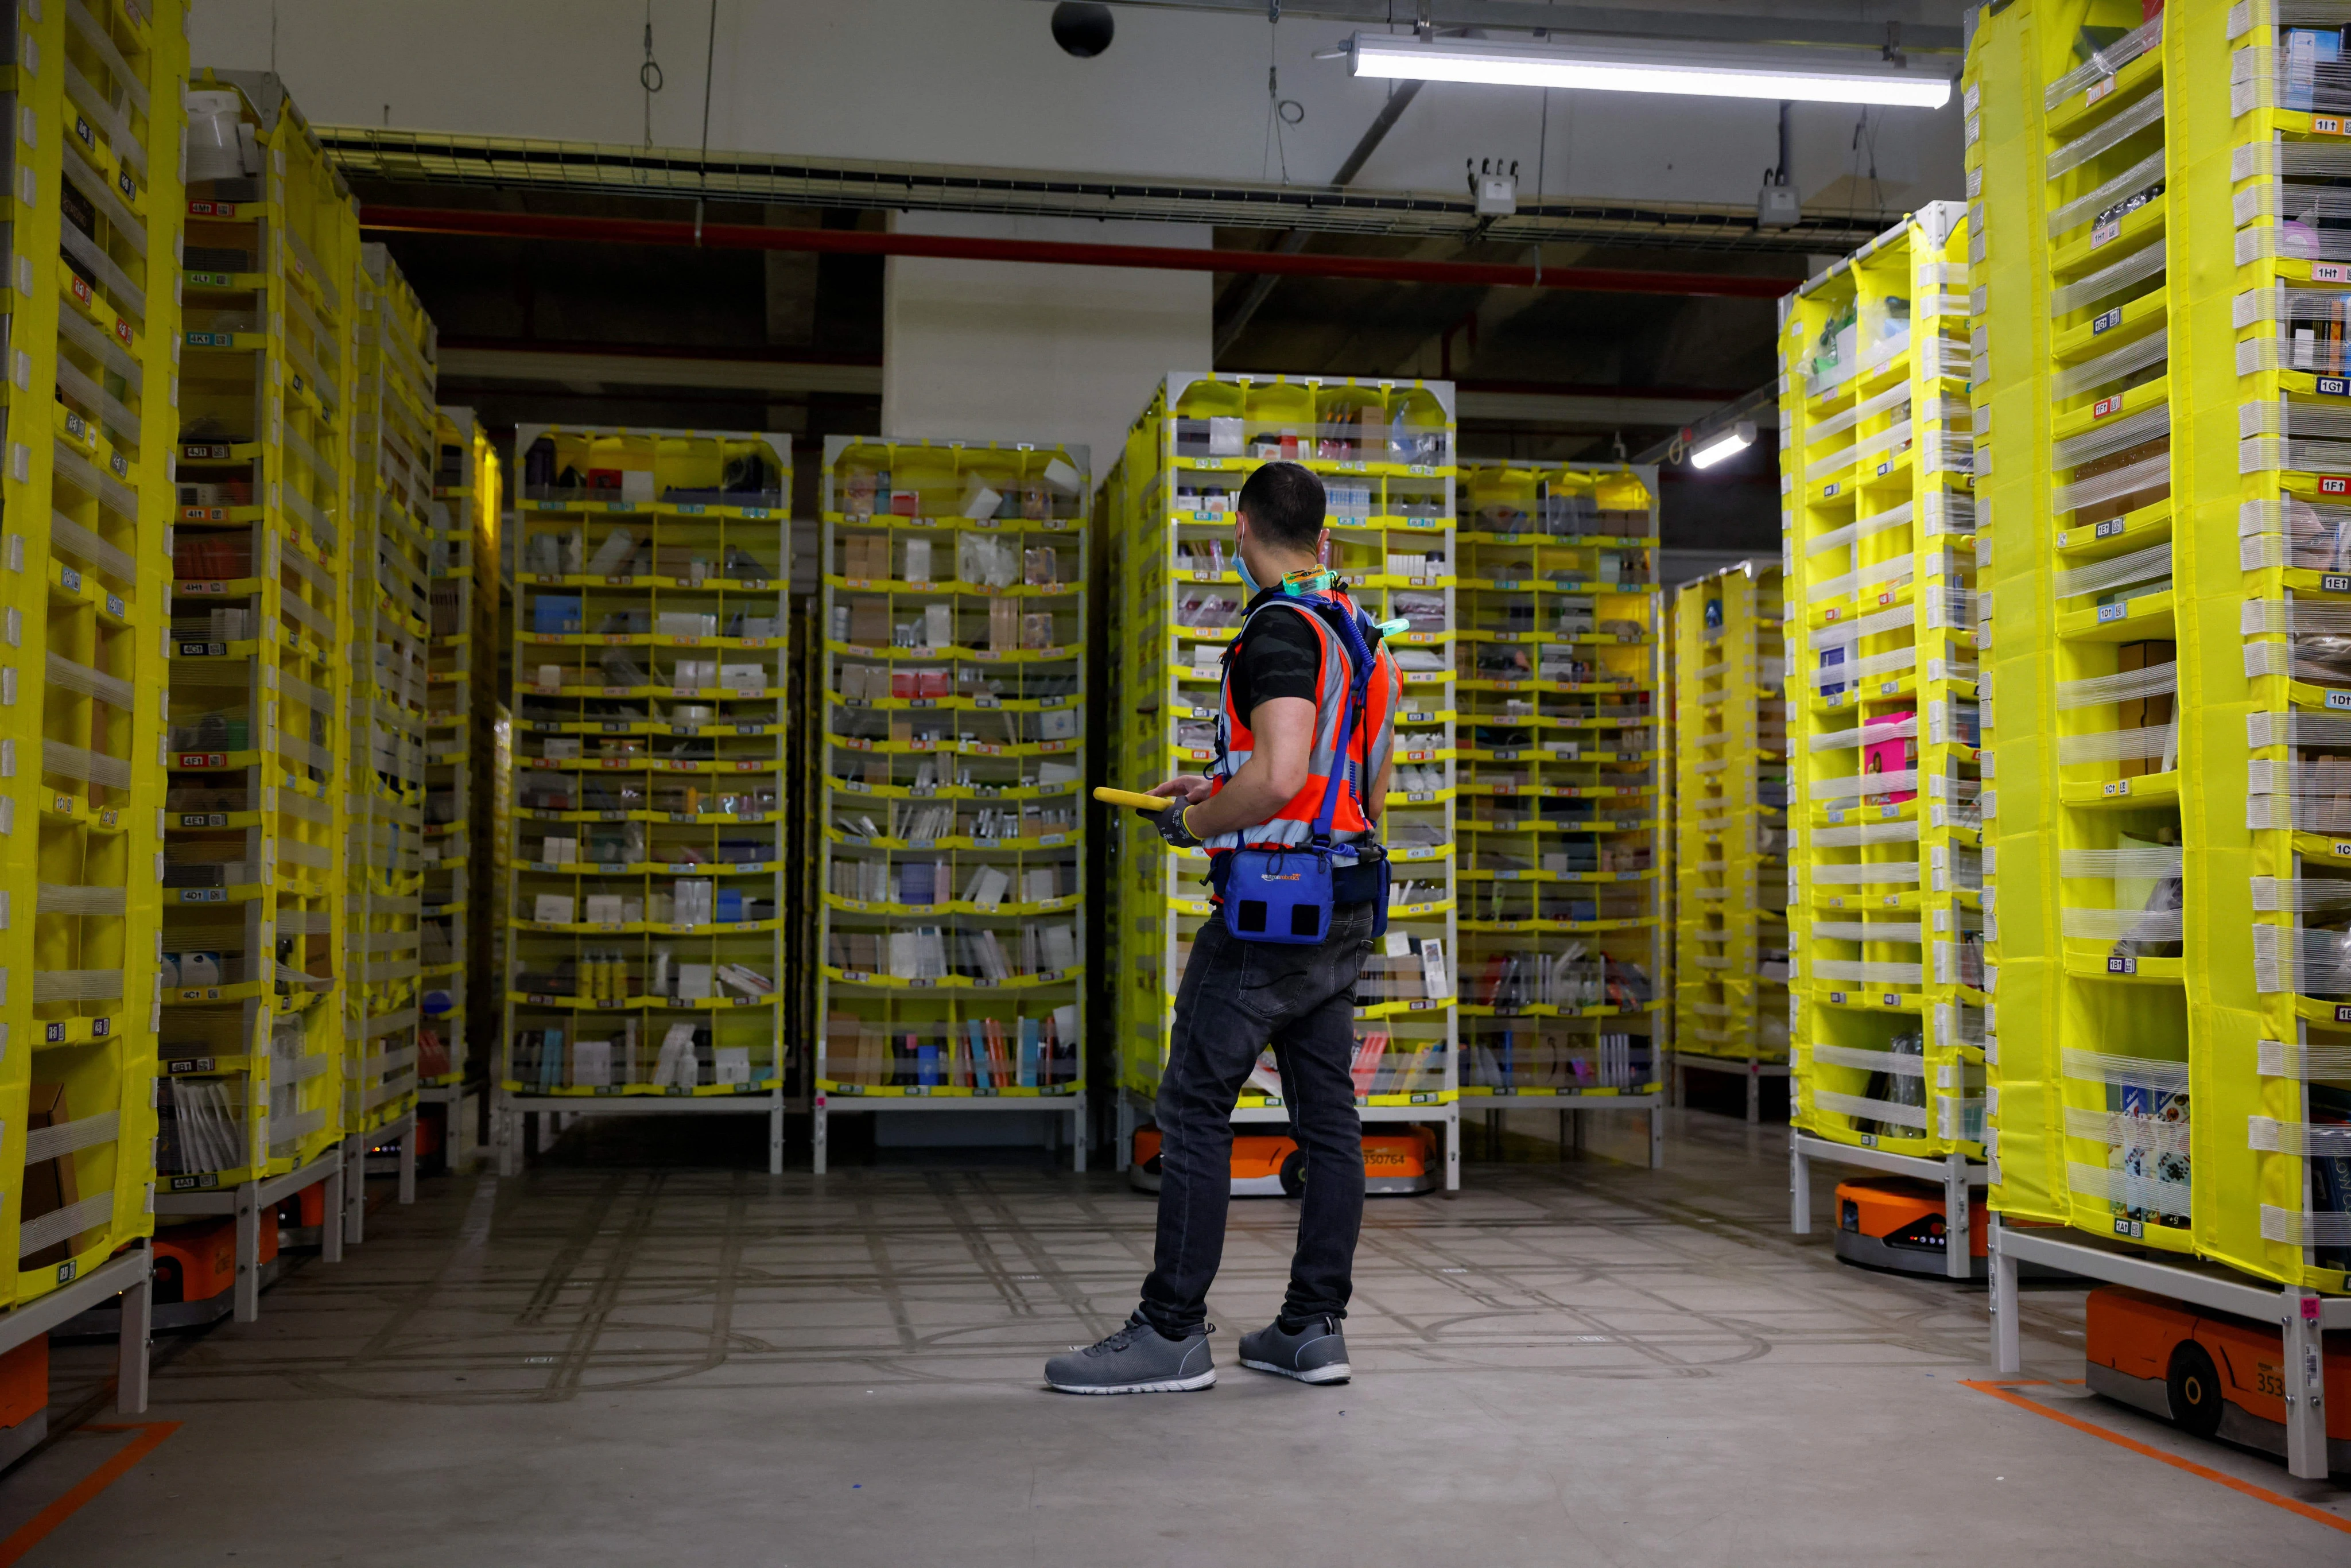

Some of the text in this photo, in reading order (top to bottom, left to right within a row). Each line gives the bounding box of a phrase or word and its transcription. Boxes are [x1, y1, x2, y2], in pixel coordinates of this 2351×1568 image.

[2318, 121, 2328, 131] 1I
[193, 203, 206, 212] 4M
[2094, 233, 2102, 243] 1H
[2318, 268, 2332, 278] 1H
[2096, 319, 2103, 331] 1G
[190, 334, 204, 343] 4K
[2322, 381, 2337, 391] 1G
[2097, 405, 2103, 413] 1F
[188, 448, 200, 456] 4J
[2325, 481, 2337, 490] 1F
[2098, 524, 2105, 534] 1E
[64, 570, 71, 584] 1D
[2327, 579, 2340, 588] 1E
[2101, 609, 2108, 618] 1D
[185, 645, 199, 653] 4G
[2331, 695, 2345, 705] 1D
[185, 757, 199, 766] 4F
[2105, 785, 2112, 794] 1C
[57, 797, 63, 809] 1C
[185, 817, 199, 825] 4E
[2337, 844, 2350, 855] 1C
[186, 891, 199, 899] 4D
[2111, 960, 2118, 968] 1B
[183, 991, 196, 999] 4C
[1364, 1154, 1405, 1165] 350764
[176, 1178, 189, 1187] 4A
[2117, 1222, 2125, 1231] 1A
[2257, 1372, 2284, 1397] 353
